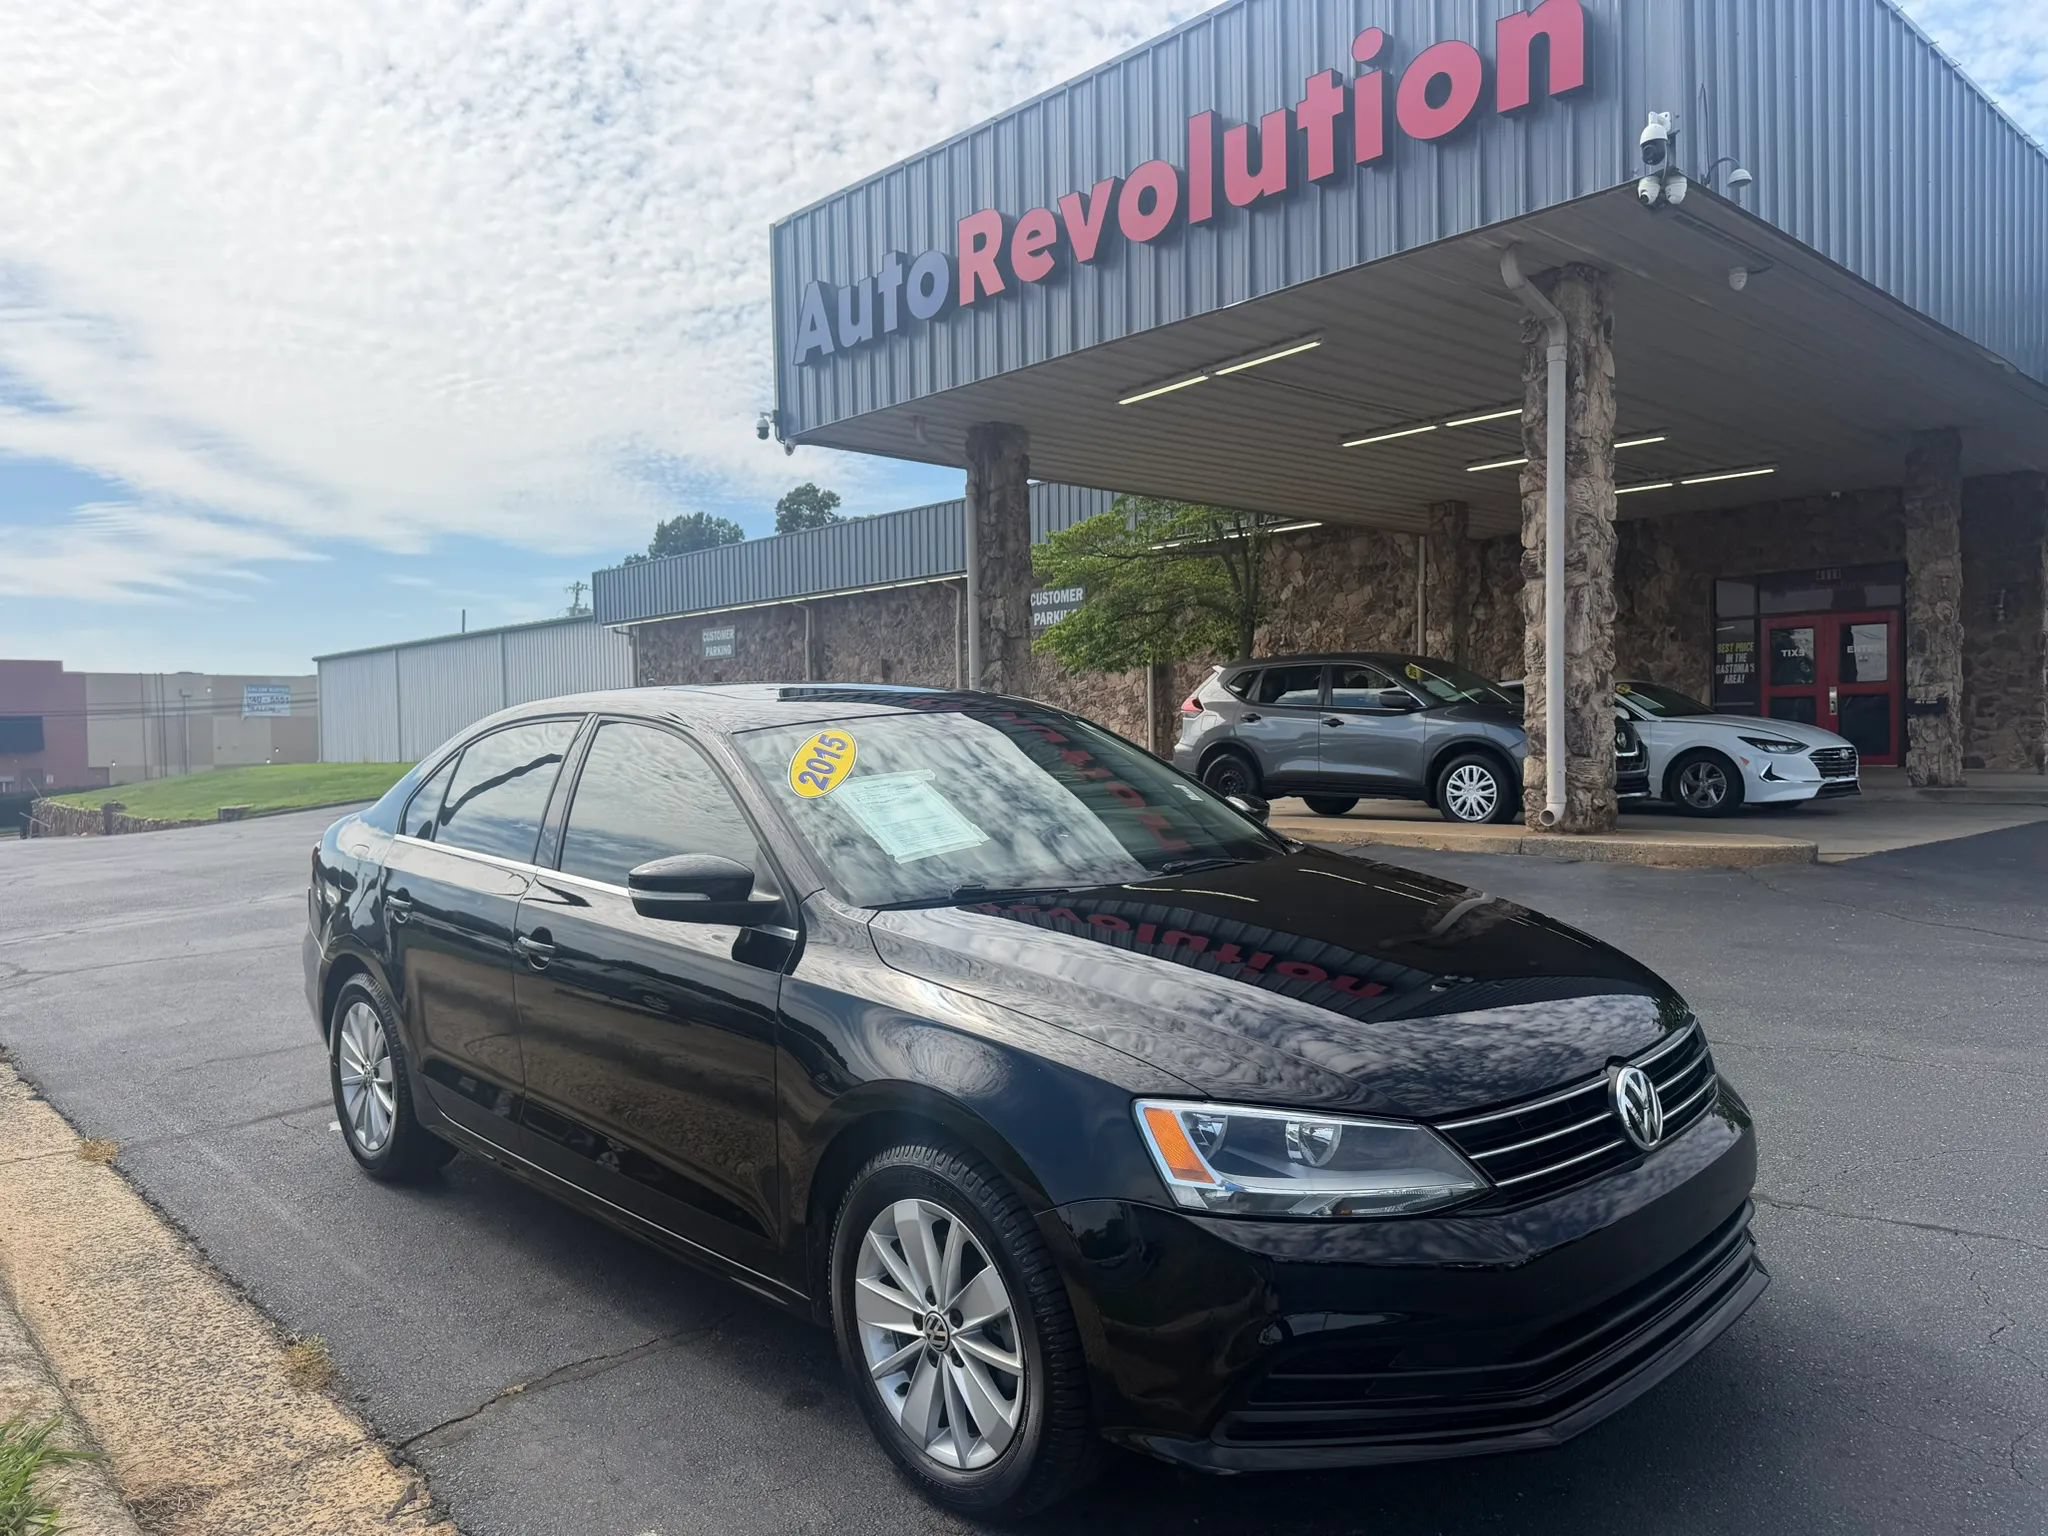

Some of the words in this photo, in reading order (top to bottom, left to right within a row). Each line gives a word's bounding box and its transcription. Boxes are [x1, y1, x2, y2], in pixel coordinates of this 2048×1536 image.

[1030, 587, 1084, 606] CUSTOMER
[1033, 608, 1078, 626] PARKI
[703, 629, 735, 642] CUSTOMER
[1716, 643, 1734, 653] BEST
[1735, 641, 1754, 652] PRICE
[1725, 653, 1734, 663] IN
[1735, 652, 1747, 663] THE
[798, 734, 848, 791] 2015
